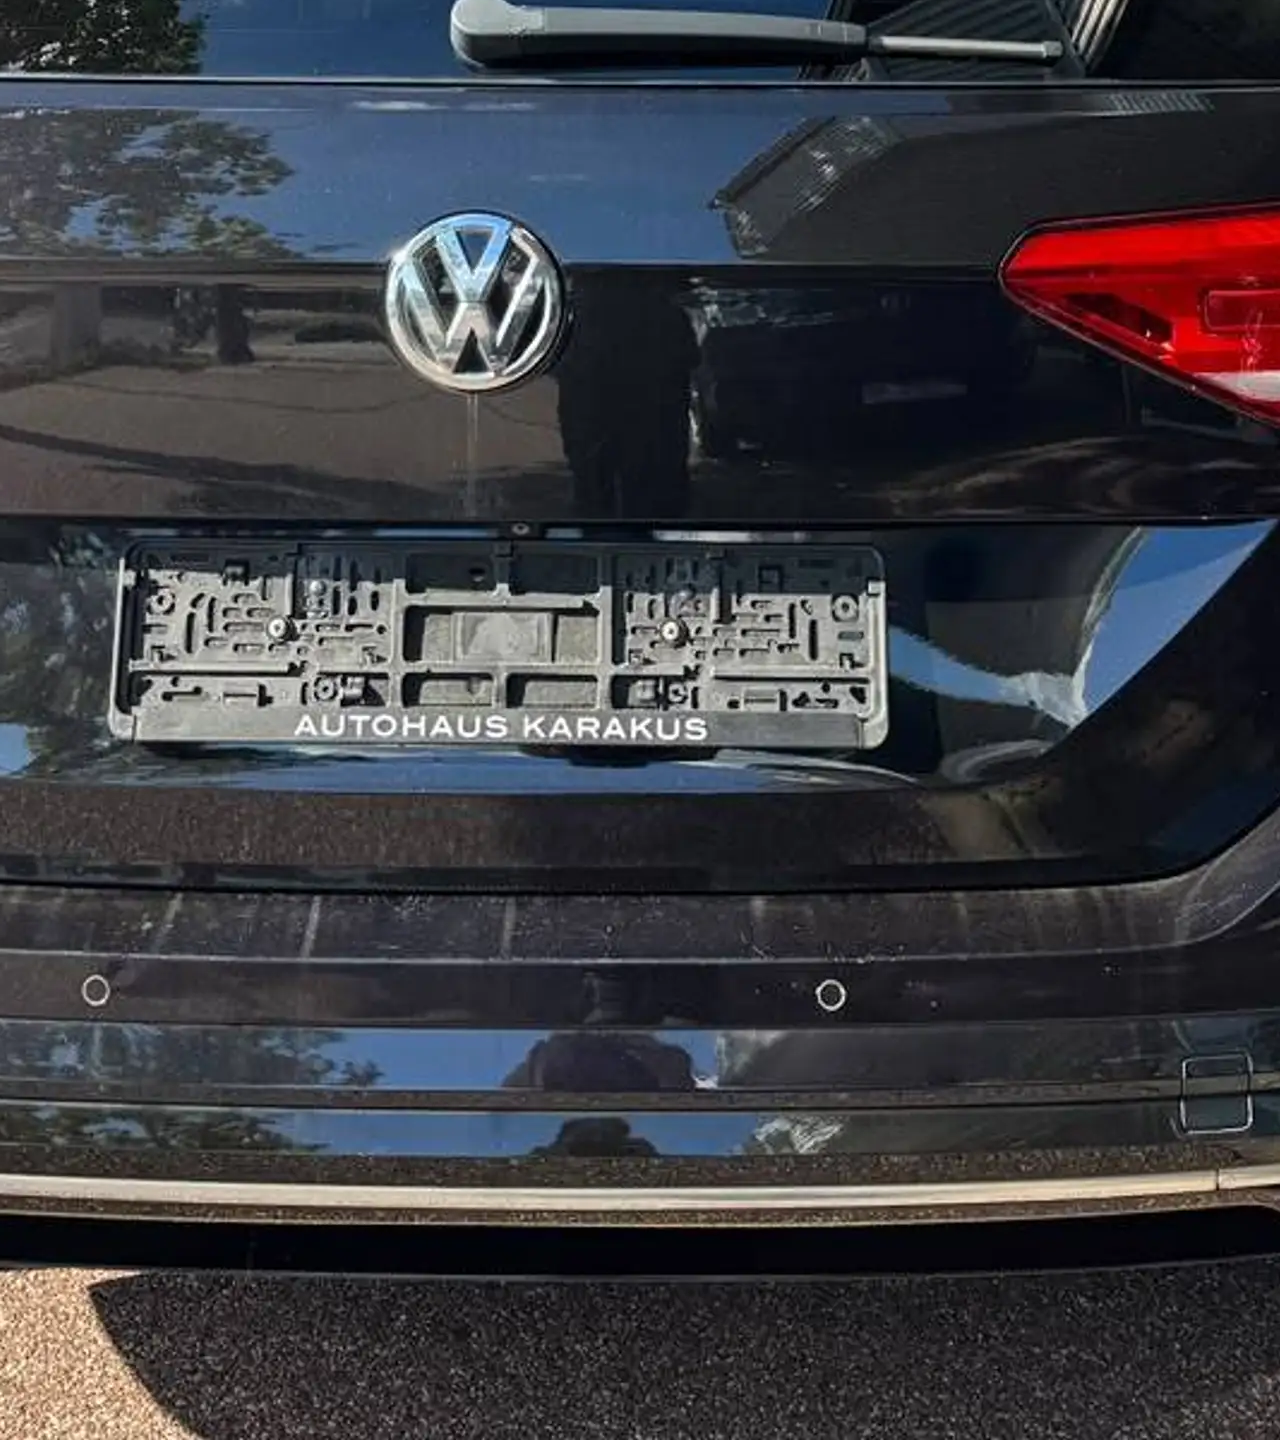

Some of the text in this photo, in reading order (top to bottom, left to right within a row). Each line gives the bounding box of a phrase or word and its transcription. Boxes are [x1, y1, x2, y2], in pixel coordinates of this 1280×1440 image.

[386, 212, 563, 392] VW
[293, 714, 709, 741] AUTOHAUS KARAKUS
